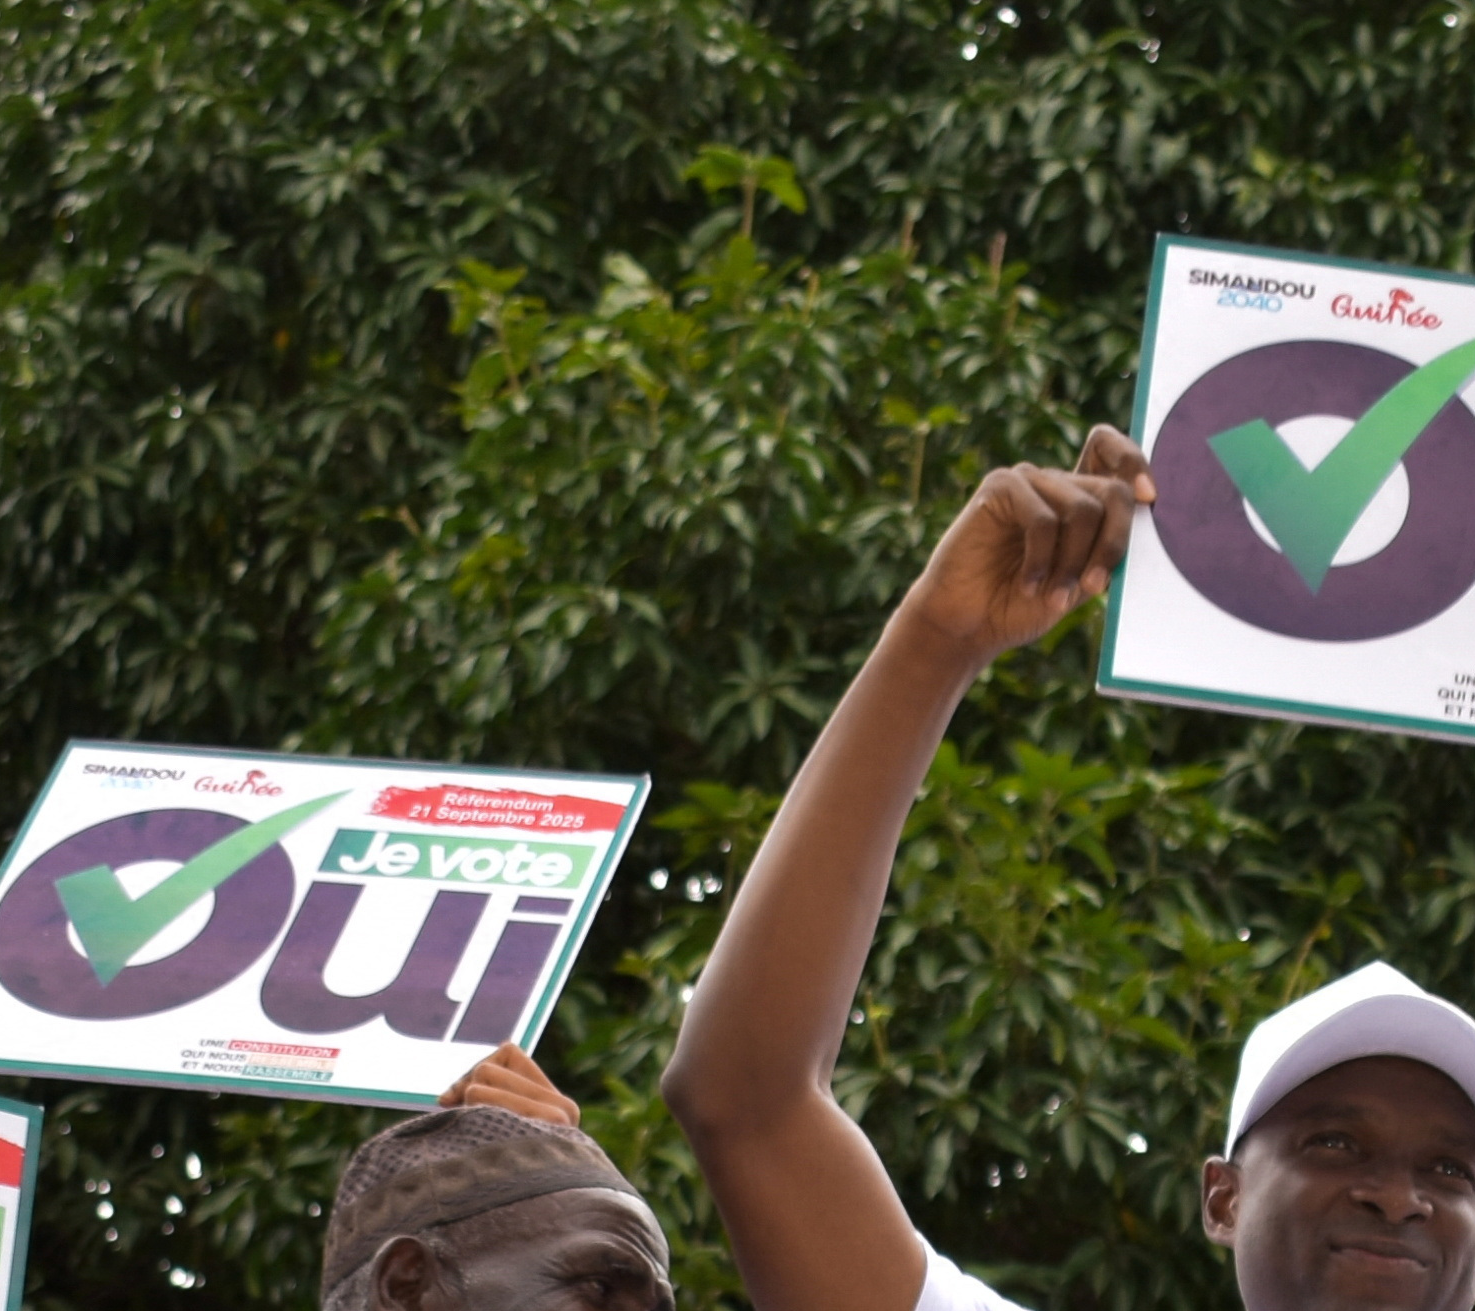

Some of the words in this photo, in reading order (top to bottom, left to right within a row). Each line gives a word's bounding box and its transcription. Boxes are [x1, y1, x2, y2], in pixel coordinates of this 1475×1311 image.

[1188, 269, 1316, 300] SIMANDOU
[1216, 289, 1283, 313] 2040
[1437, 687, 1467, 701] QUI
[1444, 704, 1463, 717] ET
[442, 792, 555, 813] Référendum
[408, 804, 431, 819] 21
[435, 806, 536, 827] Septembre
[539, 813, 587, 829] 2025
[338, 830, 421, 877] Je
[429, 842, 574, 888] vote
[230, 1040, 335, 1058] CONSTITUTION
